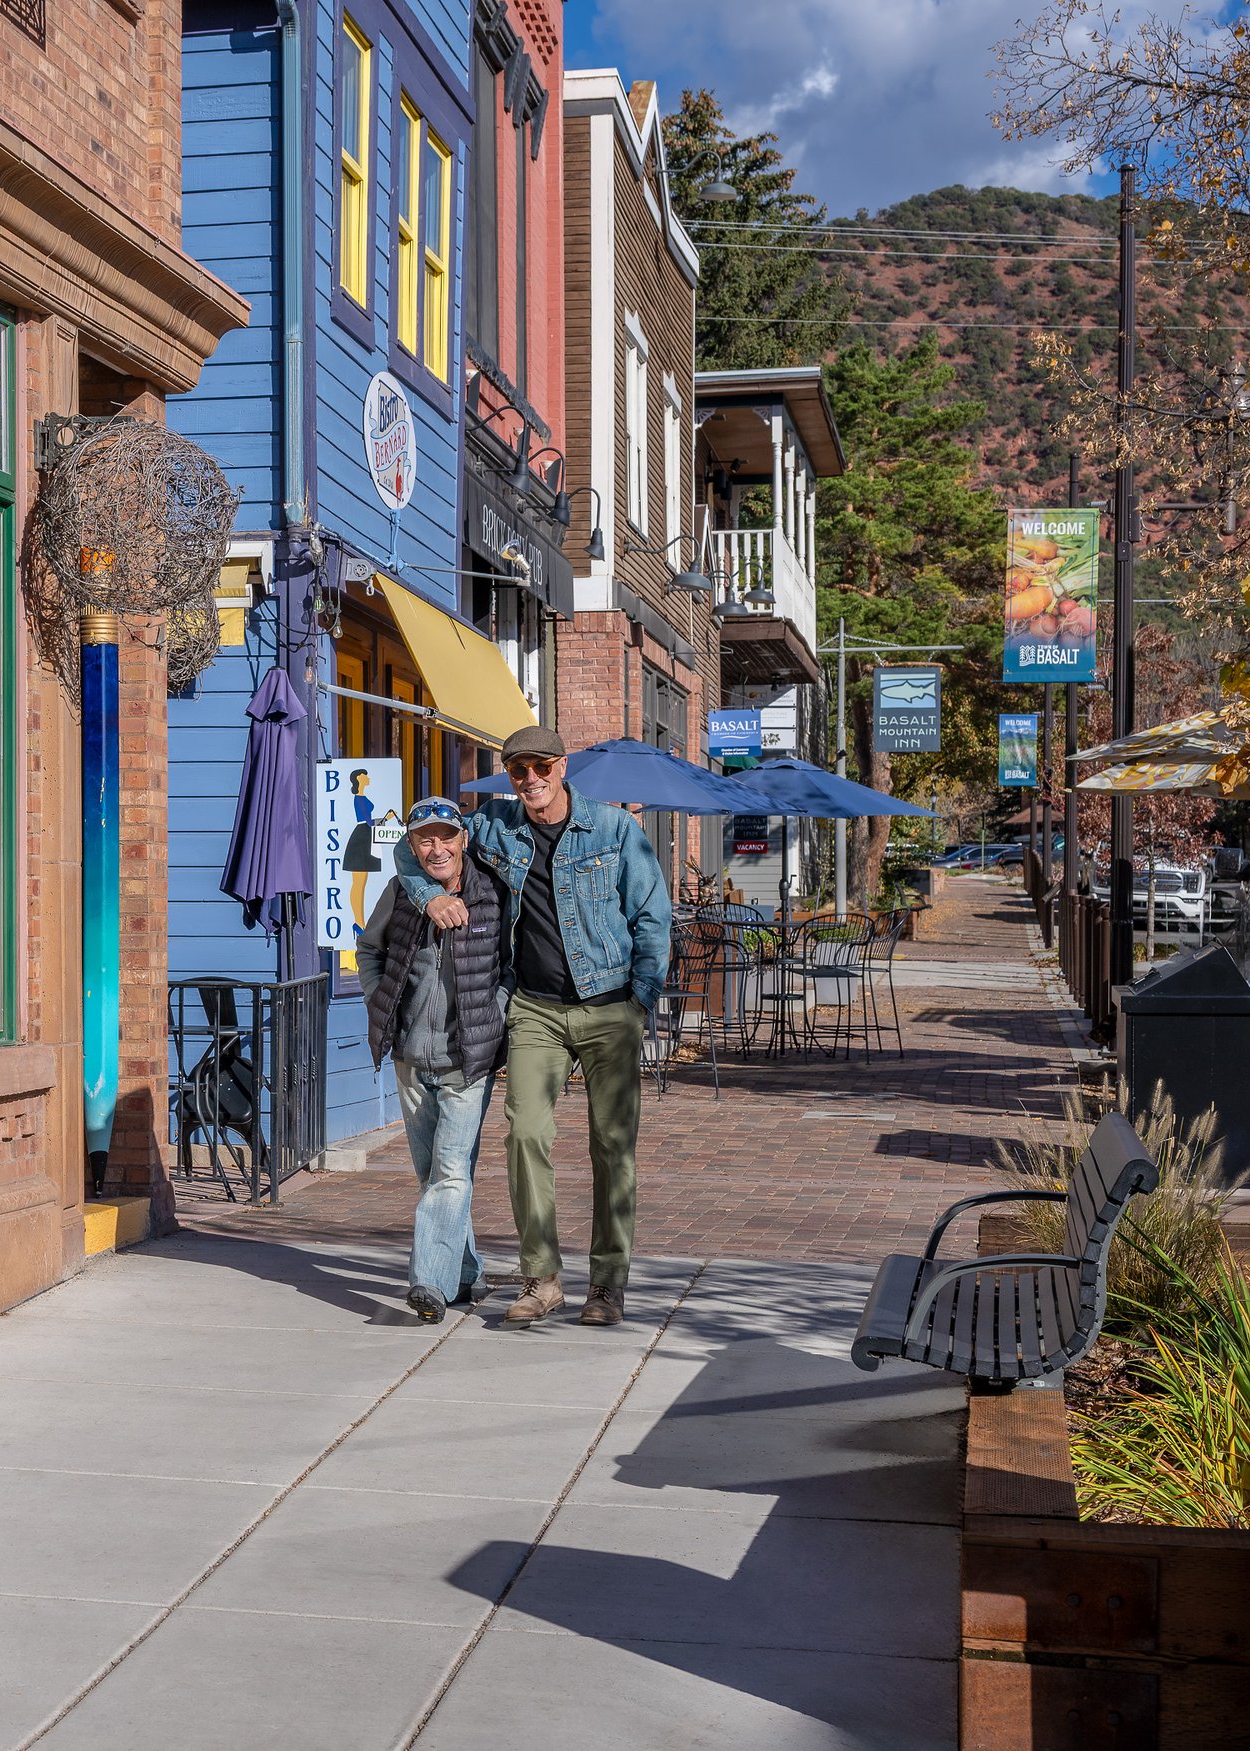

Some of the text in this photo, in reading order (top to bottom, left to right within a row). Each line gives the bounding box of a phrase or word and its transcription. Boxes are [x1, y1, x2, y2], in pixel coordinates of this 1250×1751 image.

[379, 395, 399, 433] Bistro
[374, 425, 407, 468] BERNARD
[1021, 521, 1086, 536] WELCOME
[482, 503, 507, 555] BRICK
[529, 542, 543, 586] PUB
[1036, 649, 1080, 665] BASALT
[710, 720, 759, 732] BASALT
[879, 715, 937, 726] BASALT
[1004, 719, 1032, 727] WELCOME
[879, 728, 937, 736] MOUNTAIN
[894, 739, 921, 748] INN
[378, 829, 404, 839] OPEN
[324, 769, 343, 940] BISTRO
